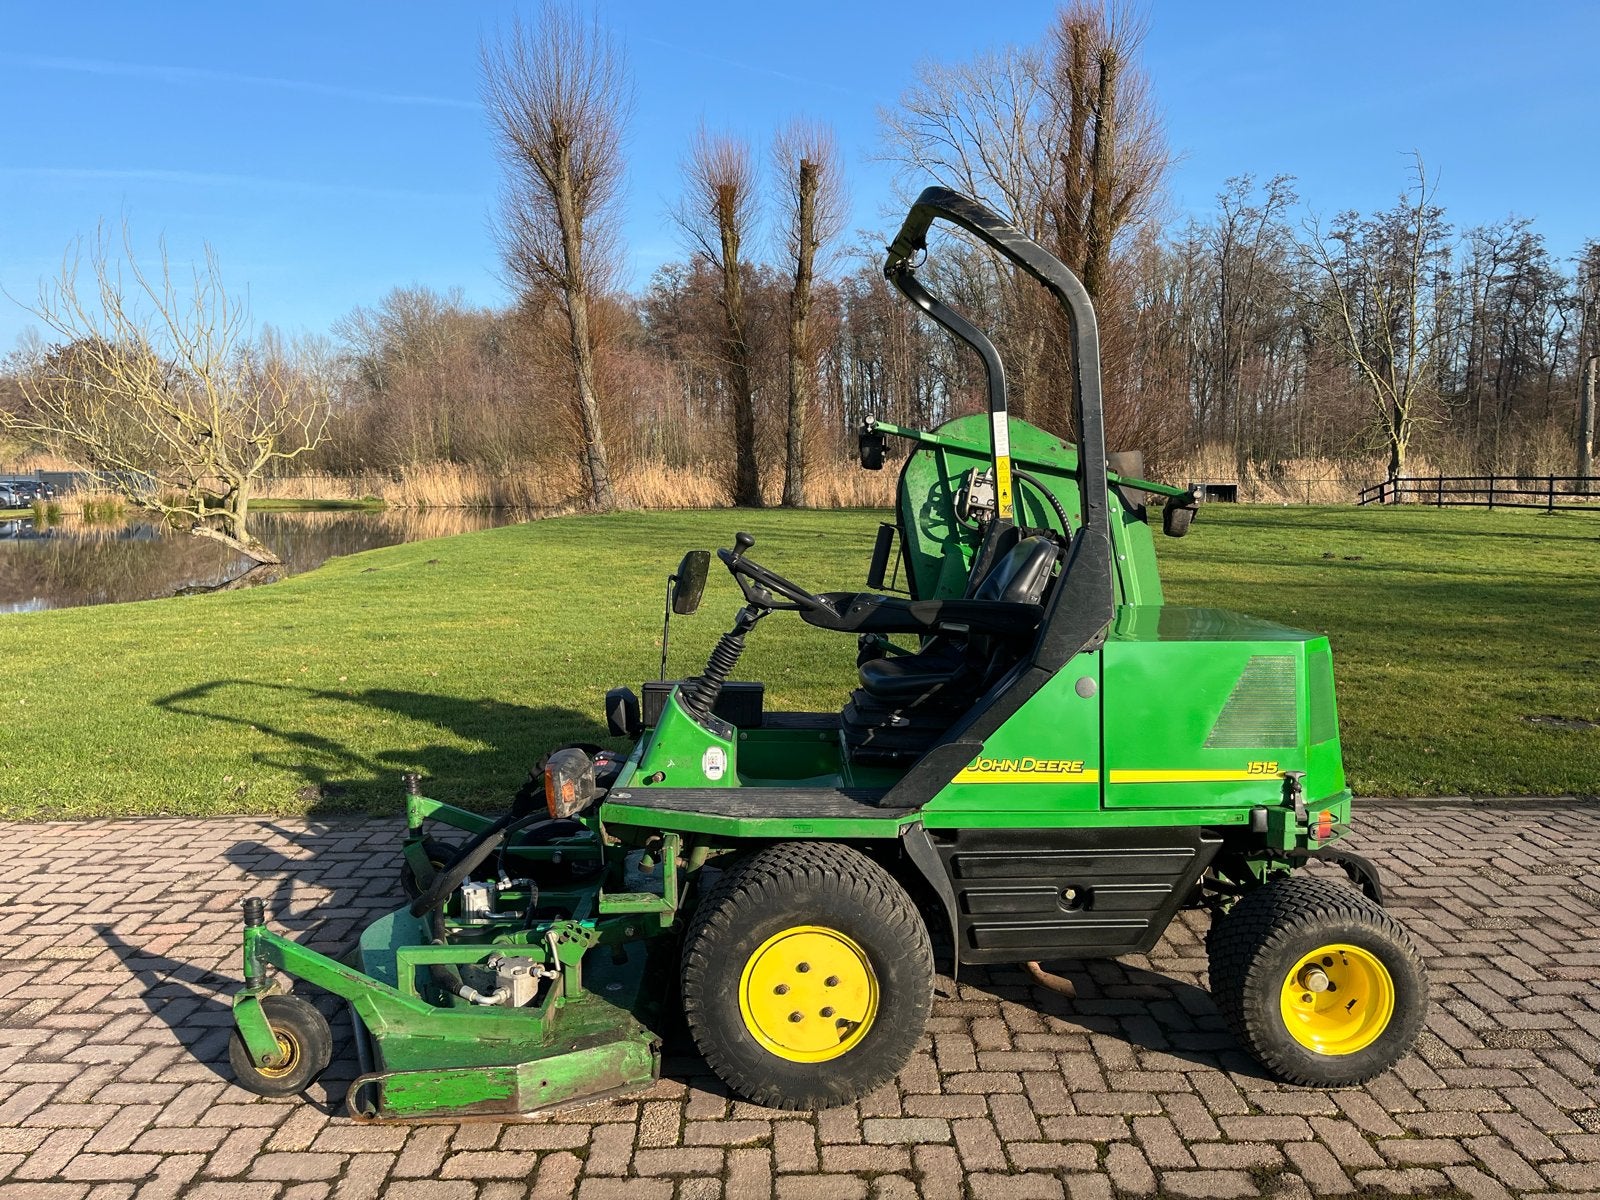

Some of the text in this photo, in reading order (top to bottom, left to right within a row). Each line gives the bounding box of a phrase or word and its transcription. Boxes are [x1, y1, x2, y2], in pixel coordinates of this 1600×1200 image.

[967, 756, 1085, 773] JOHN DEERE
[1247, 761, 1278, 774] 1515
